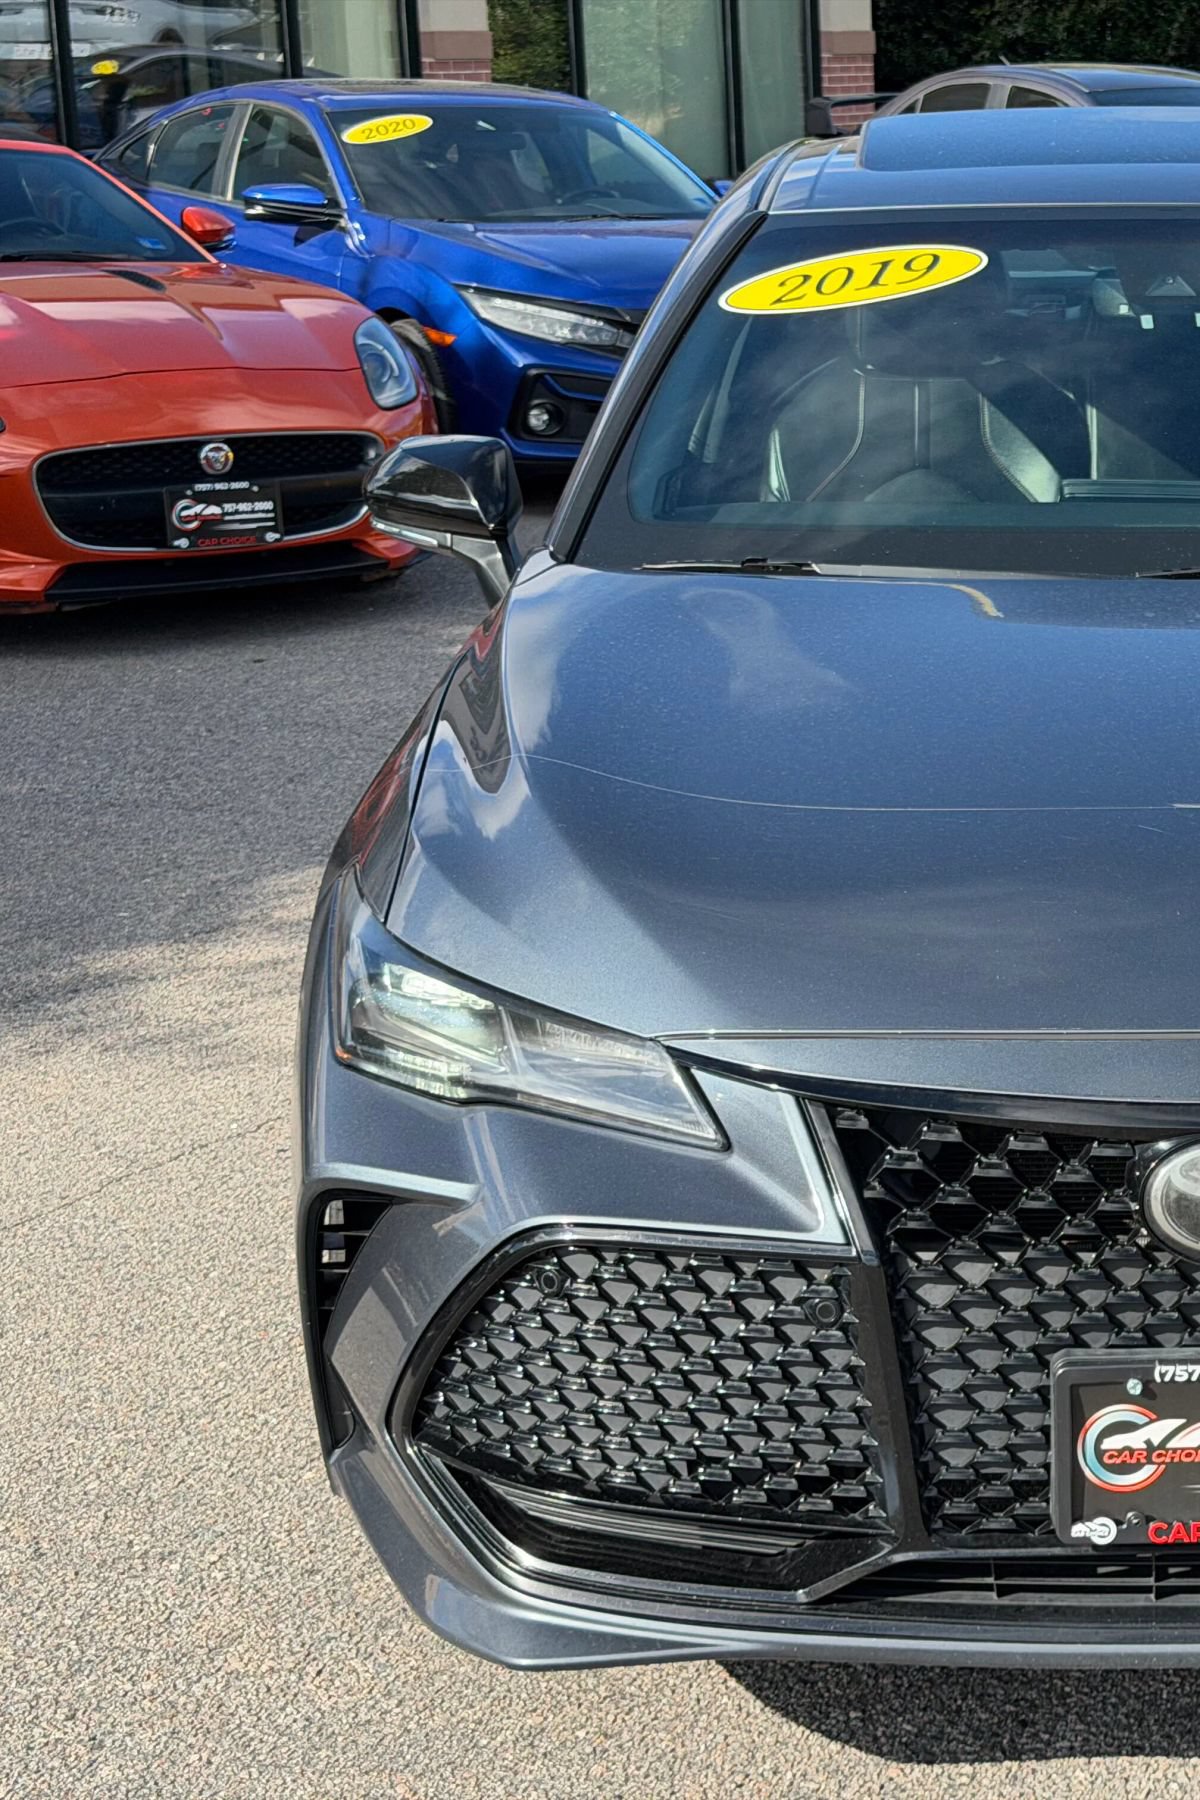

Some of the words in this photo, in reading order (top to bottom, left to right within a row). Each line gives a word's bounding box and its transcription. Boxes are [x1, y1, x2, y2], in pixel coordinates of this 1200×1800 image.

[361, 118, 417, 140] 2020
[769, 253, 941, 307] 2019
[1103, 1450, 1147, 1465] CAR
